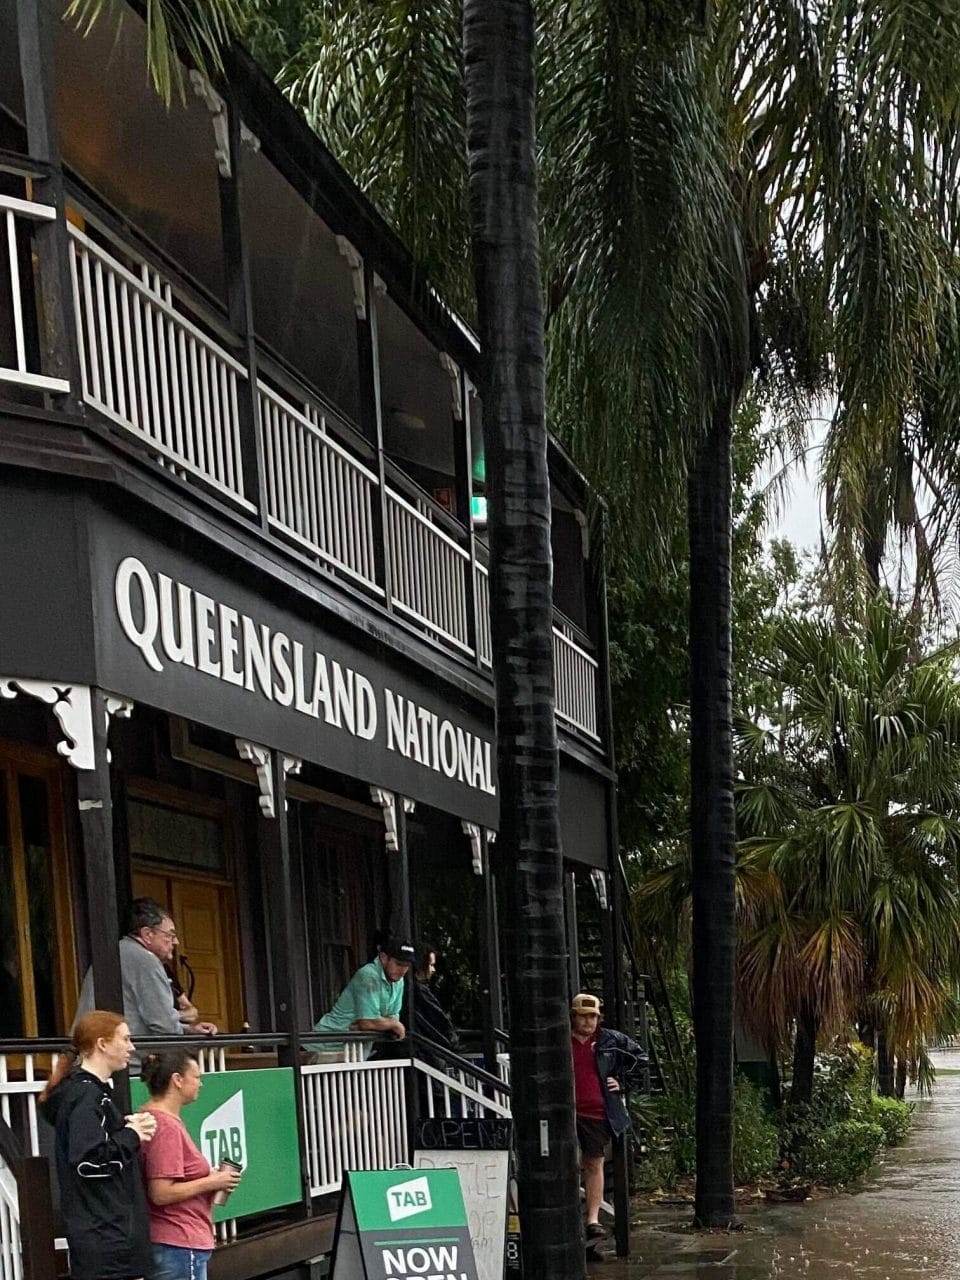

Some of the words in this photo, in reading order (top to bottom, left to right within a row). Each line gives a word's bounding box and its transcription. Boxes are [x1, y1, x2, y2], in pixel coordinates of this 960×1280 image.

[115, 557, 377, 739] QUEENSLAND
[384, 688, 496, 795] NATIONAL
[205, 1126, 243, 1167] TAB
[391, 1191, 428, 1208] TAB
[382, 1246, 458, 1275] NOW
